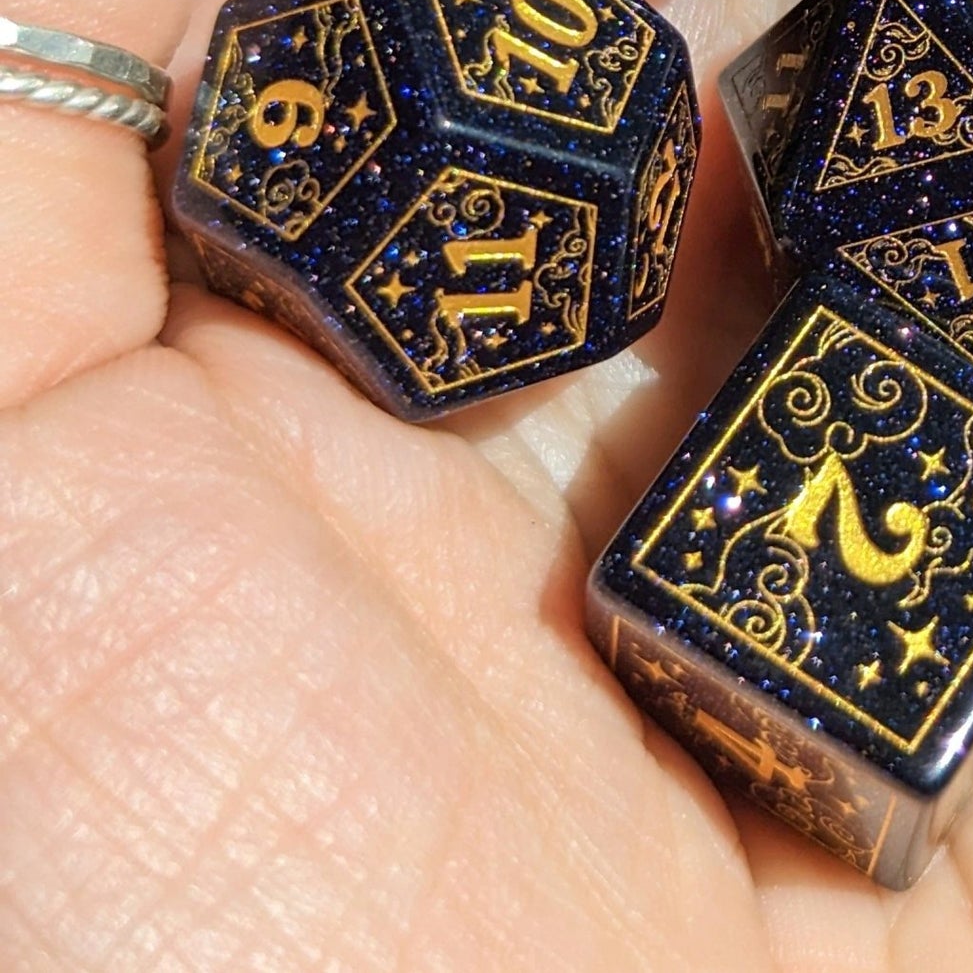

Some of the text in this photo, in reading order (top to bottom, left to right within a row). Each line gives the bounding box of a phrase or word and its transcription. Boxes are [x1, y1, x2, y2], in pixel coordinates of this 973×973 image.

[864, 70, 958, 151] 13
[439, 225, 538, 325] 11
[785, 453, 928, 585] 2
